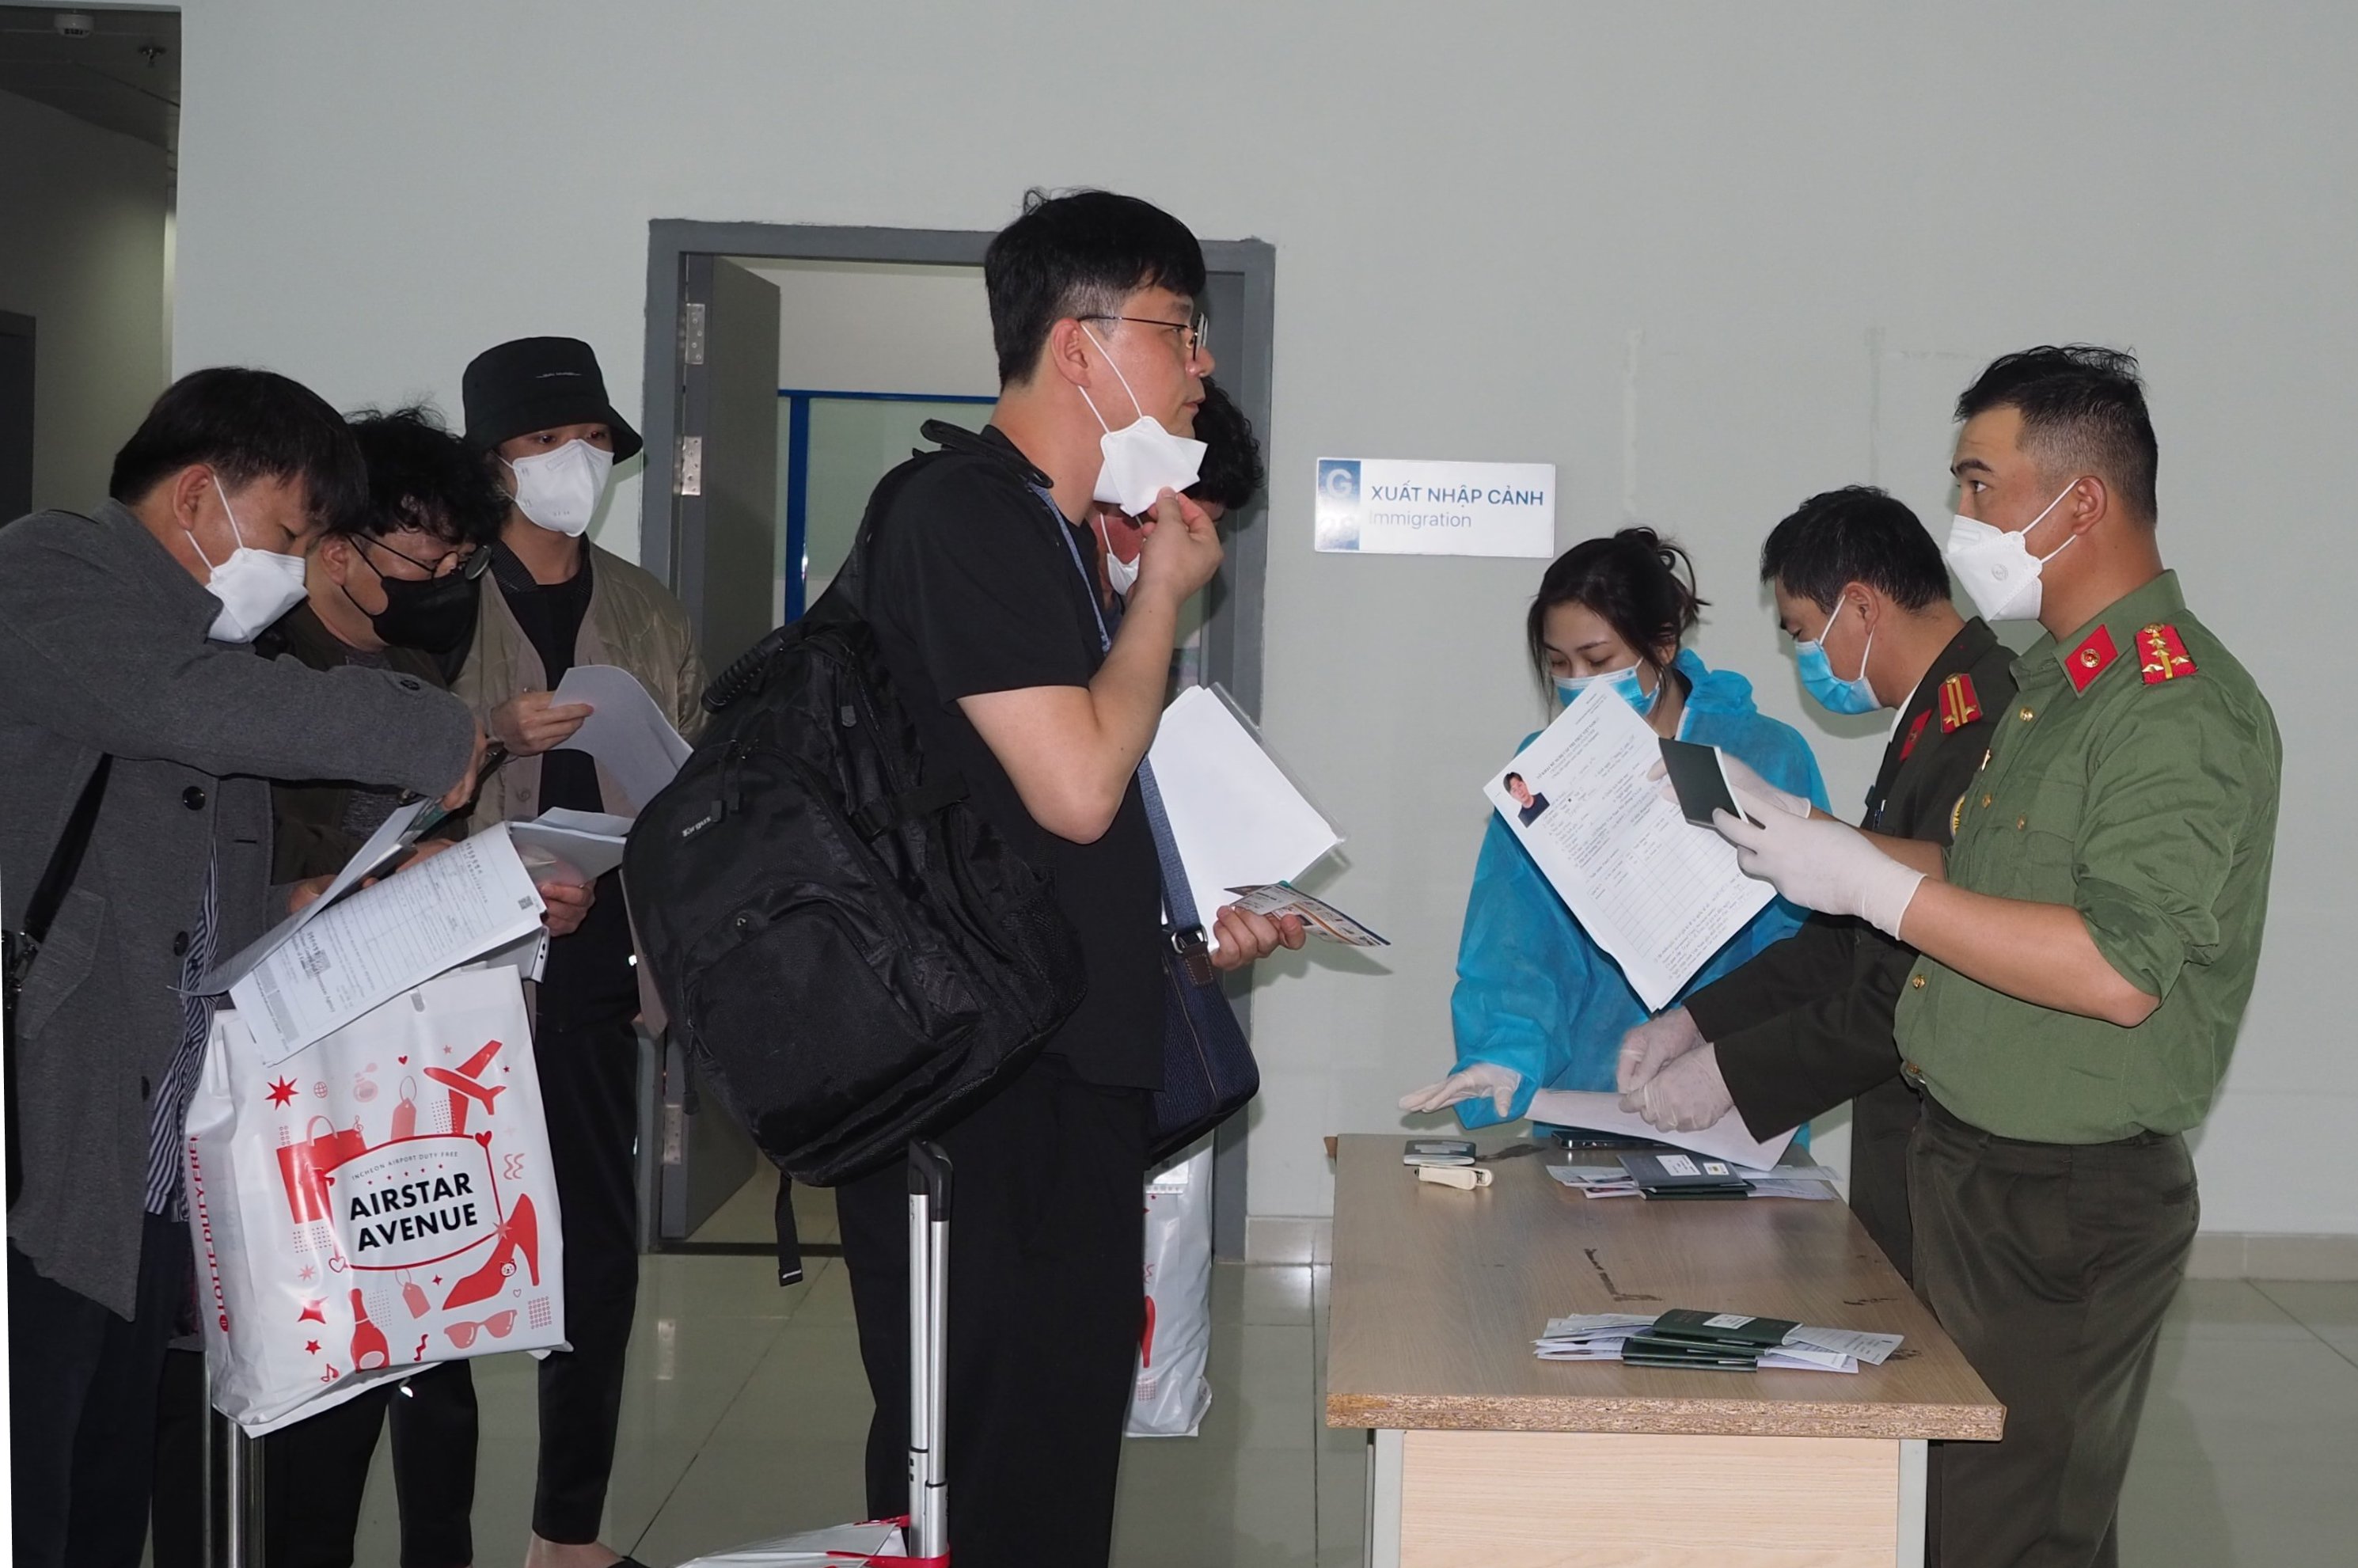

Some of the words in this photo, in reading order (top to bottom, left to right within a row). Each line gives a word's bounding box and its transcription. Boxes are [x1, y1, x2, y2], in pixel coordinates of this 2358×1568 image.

[1326, 468, 1353, 499] G
[1371, 480, 1422, 502] XUẤT
[1427, 484, 1482, 507] NHẬP
[1487, 484, 1544, 506] CẢNH
[1369, 511, 1471, 529] Immigration
[351, 1164, 385, 1181] INCHEON
[388, 1155, 416, 1166] AIRPORT
[350, 1172, 474, 1221] AIRSTAR
[358, 1202, 478, 1252] AVENUE
